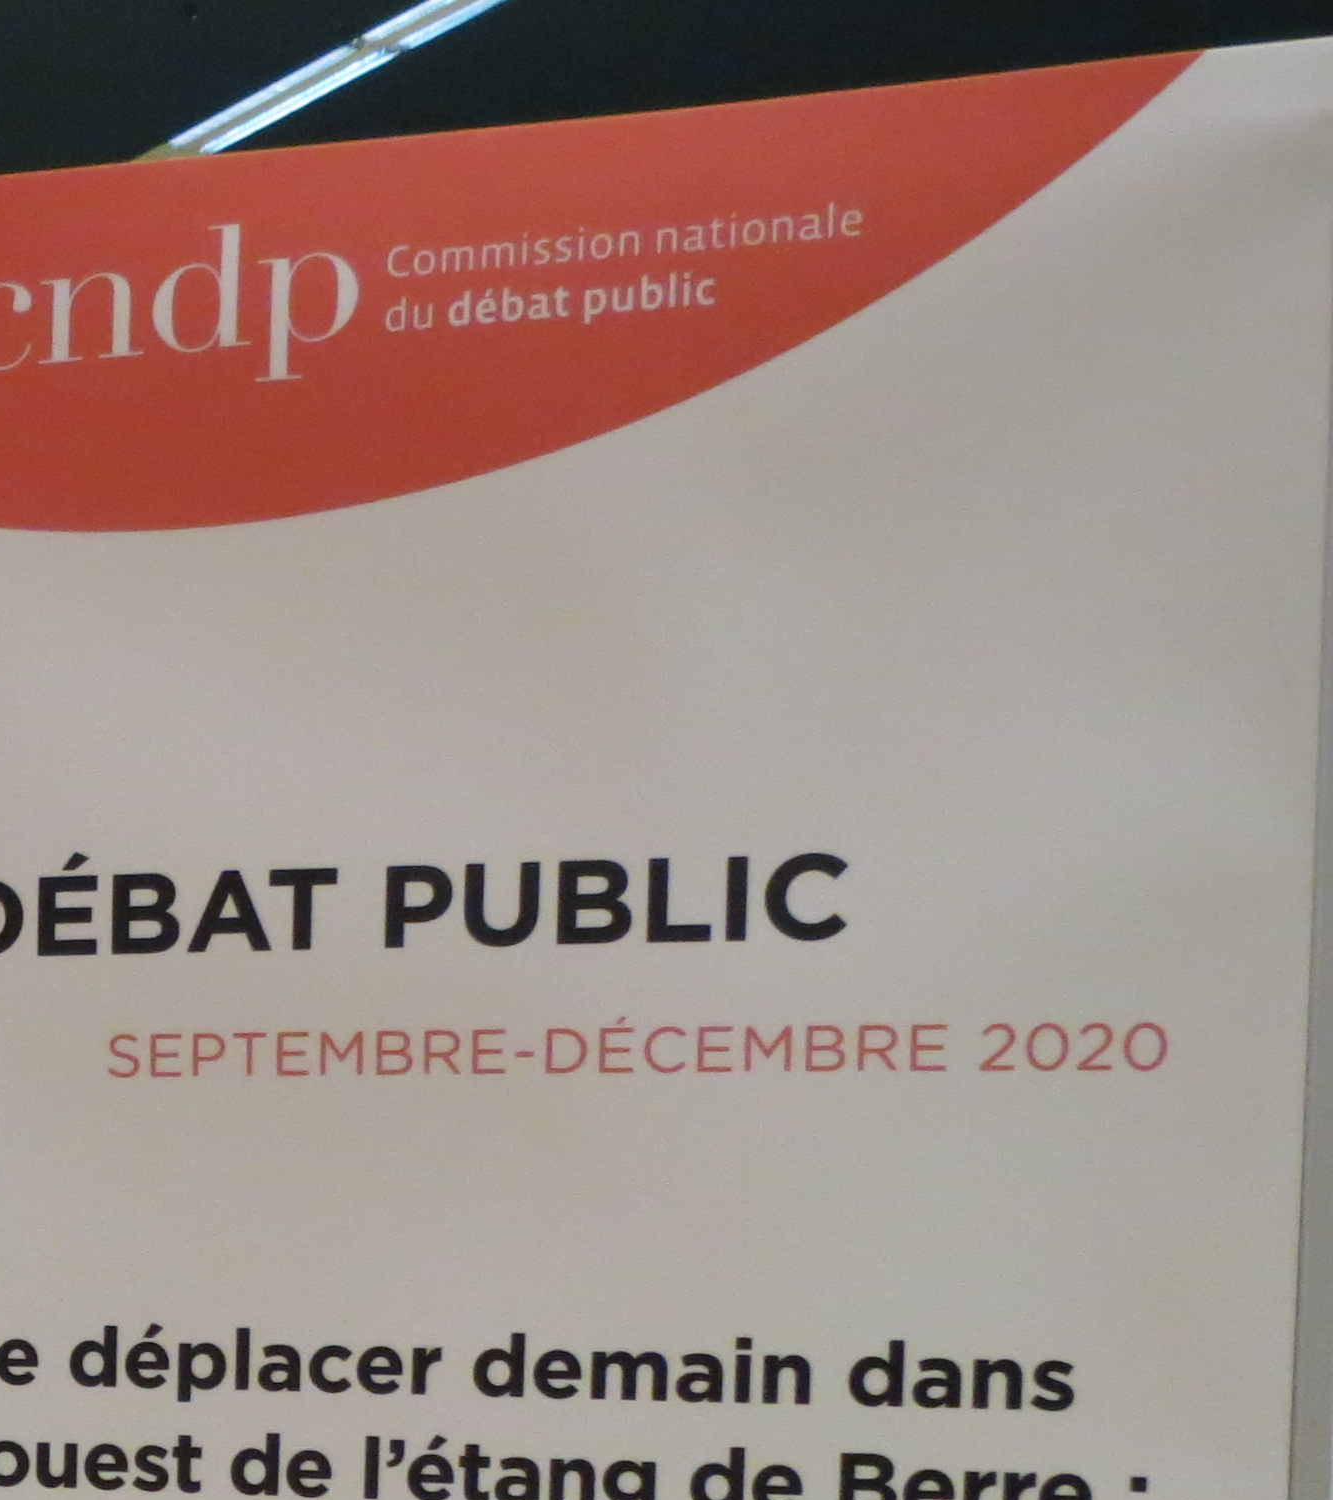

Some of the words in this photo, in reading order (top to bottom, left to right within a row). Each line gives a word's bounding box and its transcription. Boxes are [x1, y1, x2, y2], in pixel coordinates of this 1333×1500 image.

[386, 225, 642, 279] Commission
[656, 203, 864, 254] nationale
[384, 295, 434, 333] du
[447, 283, 570, 327] débat
[583, 273, 717, 323] public
[384, 852, 850, 951] PUBLIC
[107, 1016, 947, 1080] SEPTEMBRE-DÉCEMBRE
[979, 1021, 1169, 1073] 2020
[68, 1325, 443, 1402] déplacer
[472, 1332, 812, 1407] demain
[847, 1340, 1076, 1411] dans
[229, 1431, 332, 1498] de
